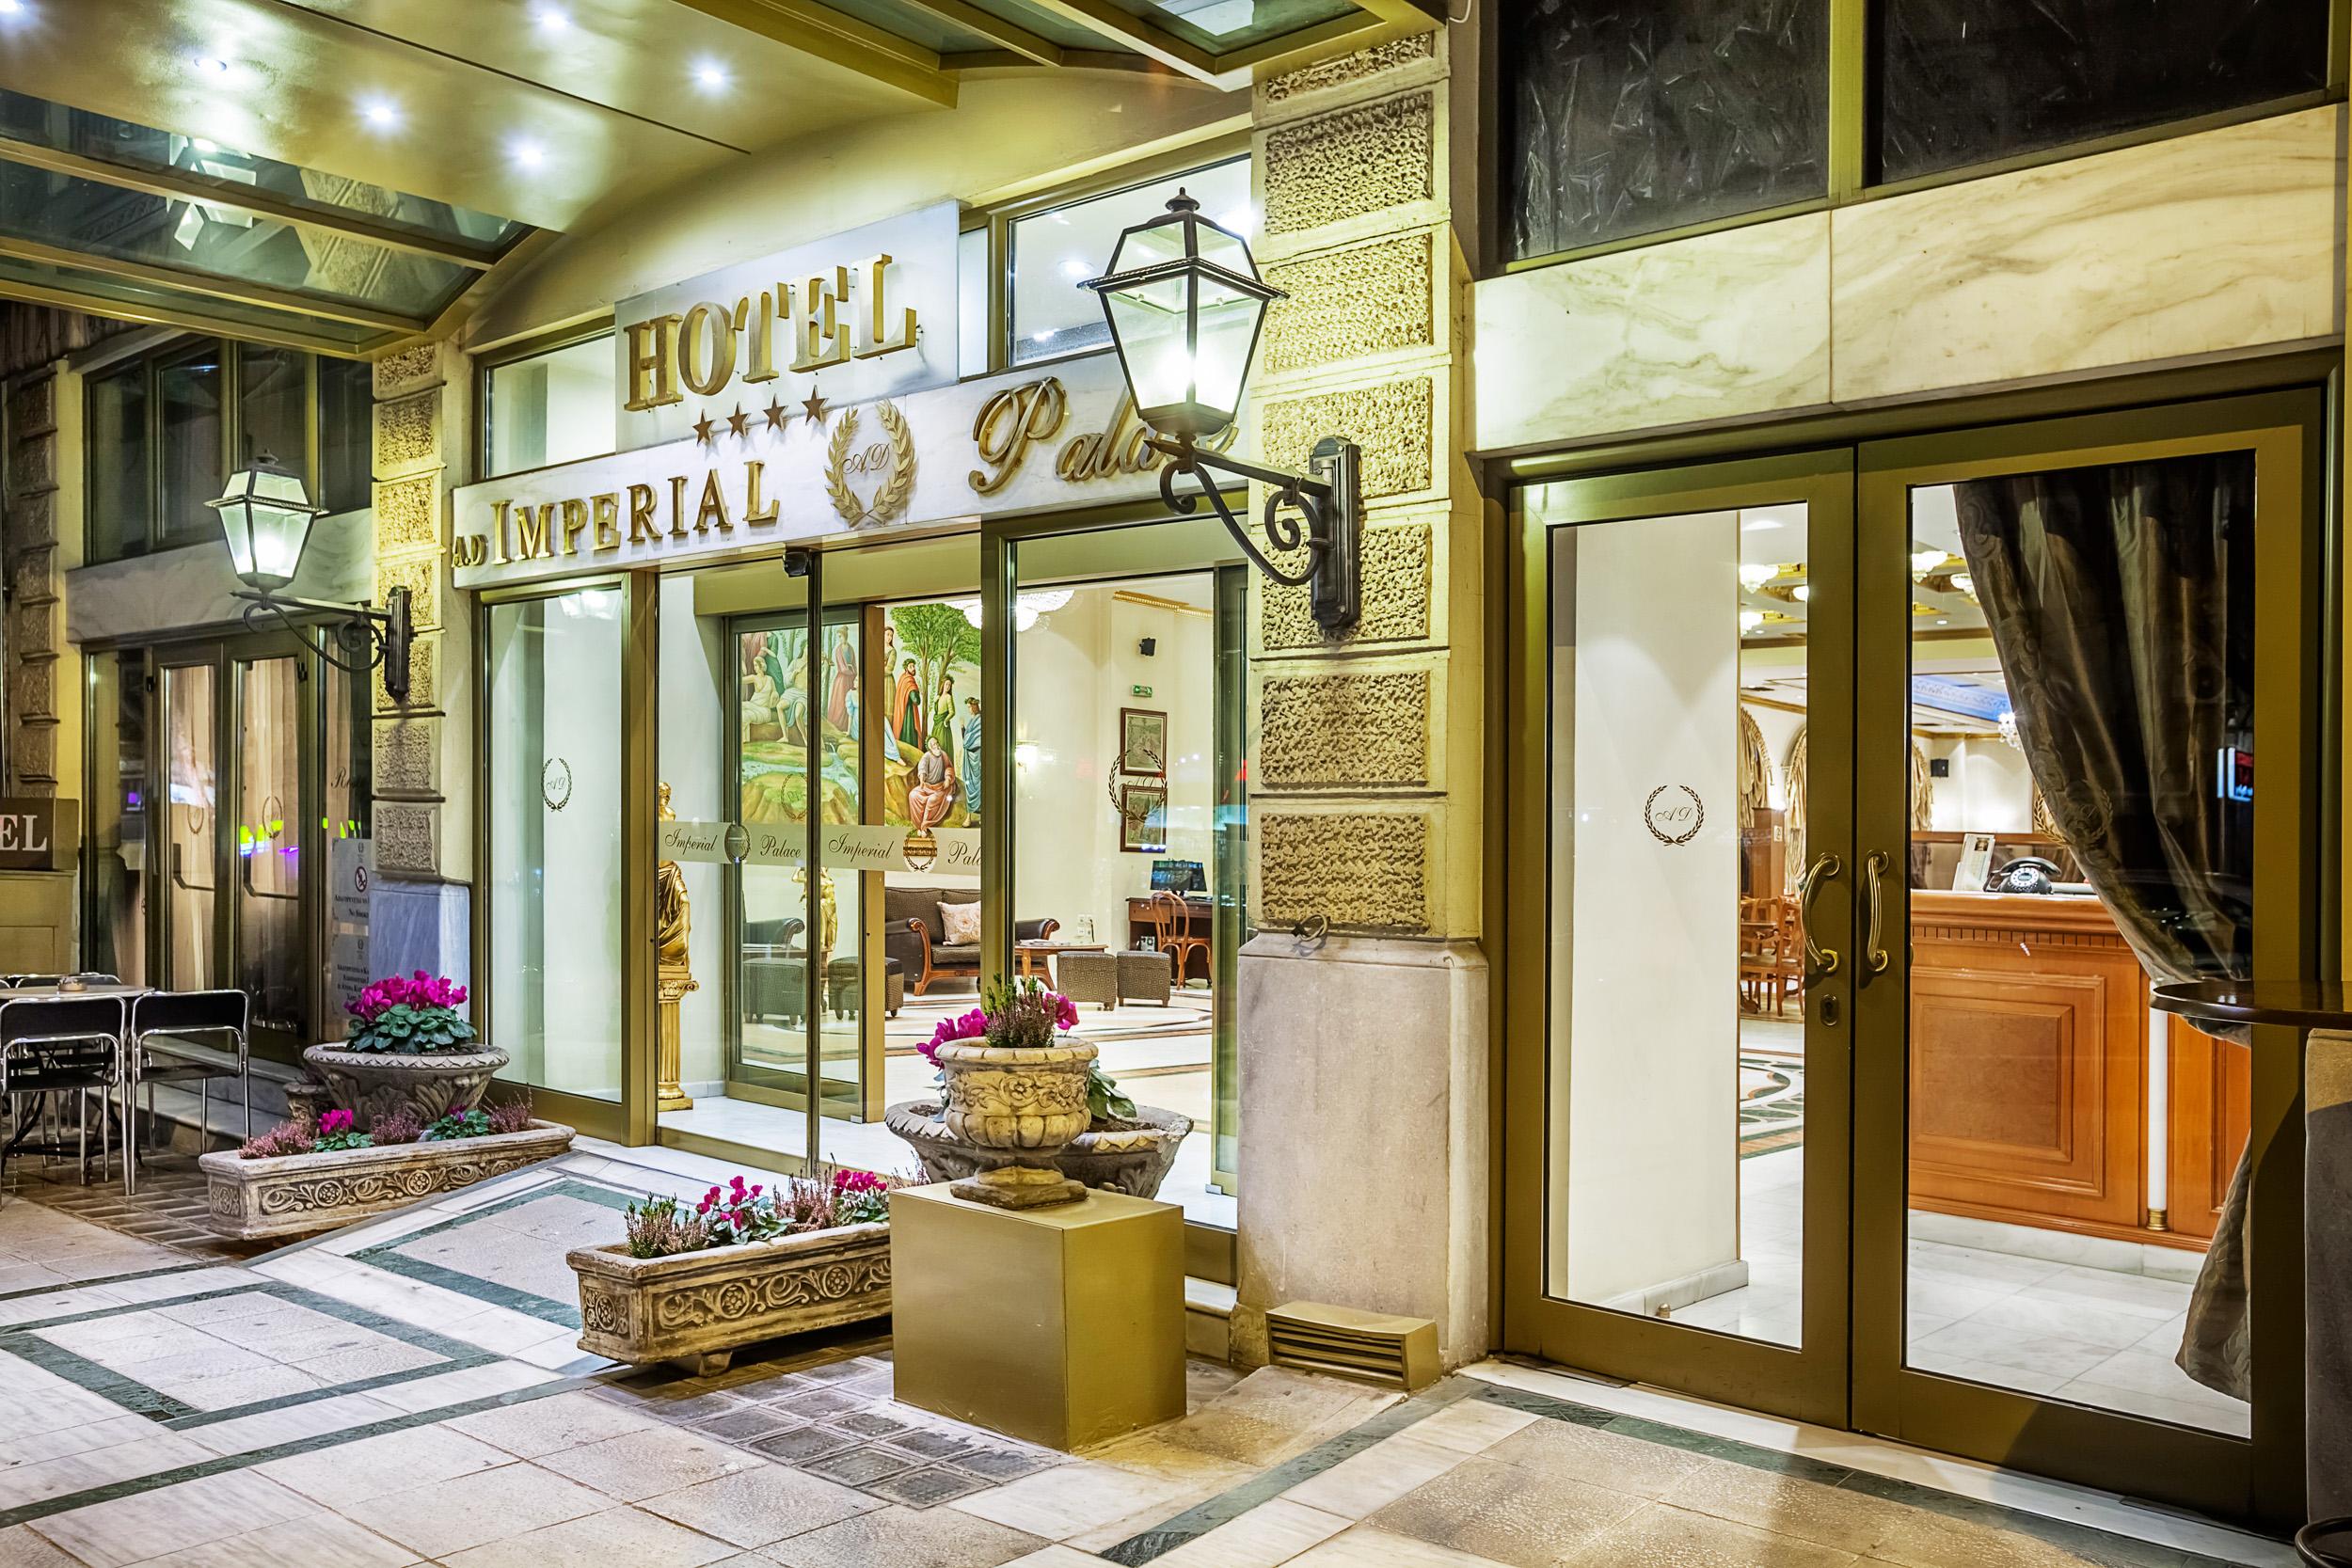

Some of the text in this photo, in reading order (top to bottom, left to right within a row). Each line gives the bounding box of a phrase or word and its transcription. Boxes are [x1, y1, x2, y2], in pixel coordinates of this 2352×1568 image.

[624, 253, 917, 412] HOTEL
[490, 459, 783, 564] IMPERIAL
[968, 376, 1240, 497] Pala
[0, 815, 48, 852] EL
[664, 828, 802, 858] Imperial Palace
[828, 832, 981, 865] Imperial Pal
